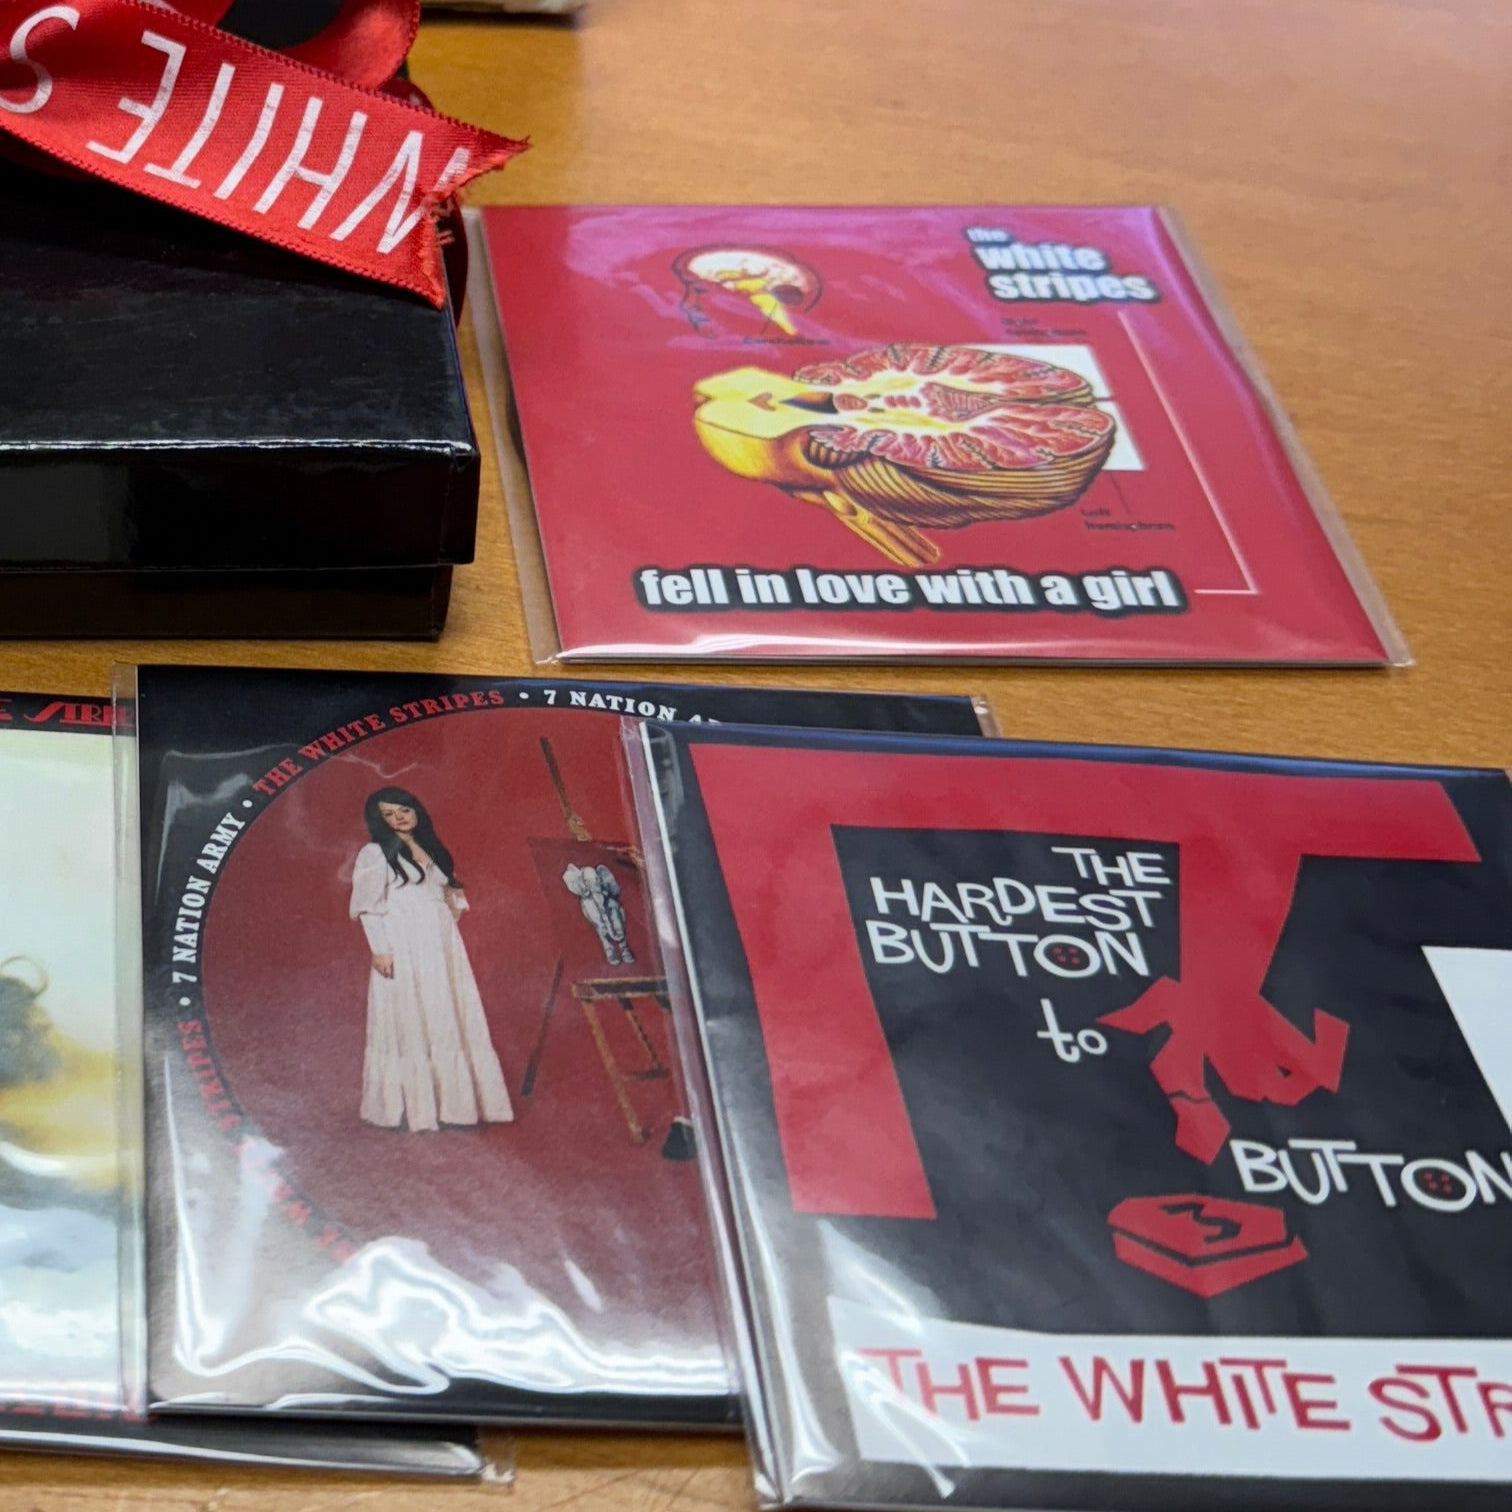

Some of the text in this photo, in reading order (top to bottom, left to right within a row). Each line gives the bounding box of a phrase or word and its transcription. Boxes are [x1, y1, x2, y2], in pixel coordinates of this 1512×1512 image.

[87, 29, 472, 255] WHITE
[974, 242, 1107, 271] white
[988, 271, 1158, 302] stripes
[639, 567, 1182, 611] fell in love with a girl
[543, 689, 558, 705] 7
[569, 691, 678, 721] NATION
[252, 689, 505, 796] THE WHITE STRIPES
[1051, 846, 1171, 887] THE
[172, 811, 245, 984] 7 NATION ARMY
[869, 876, 1163, 932] HARDEST
[865, 918, 1152, 978] BUTTON
[1036, 998, 1109, 1063] to
[855, 1347, 1041, 1422] THE
[1058, 1354, 1351, 1431] WHITE
